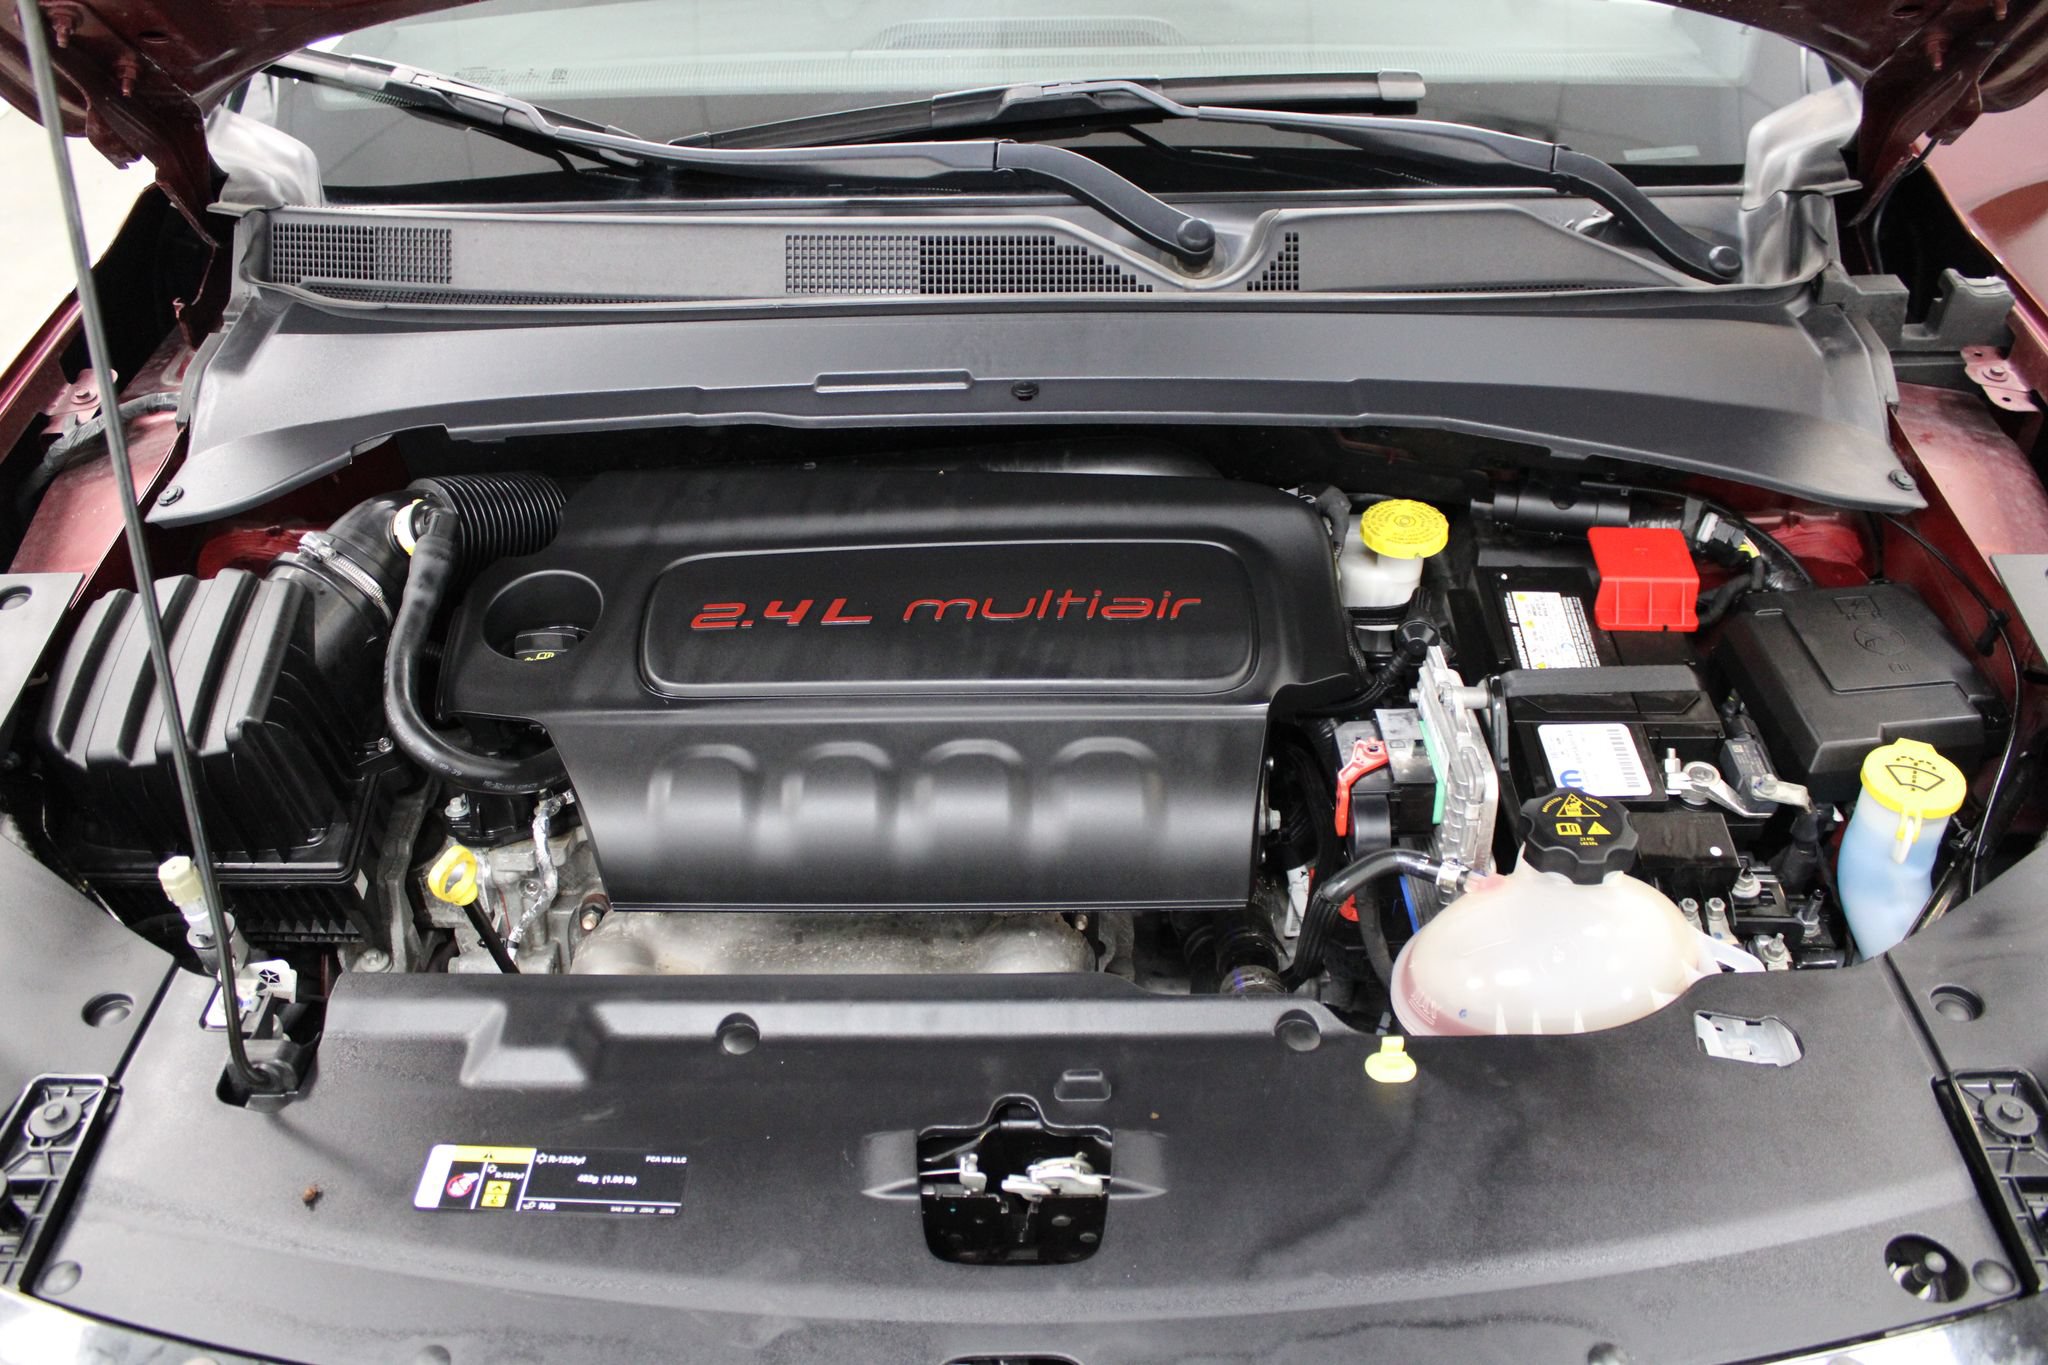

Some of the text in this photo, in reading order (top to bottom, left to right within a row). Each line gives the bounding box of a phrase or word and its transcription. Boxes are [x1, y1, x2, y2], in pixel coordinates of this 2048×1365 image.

[902, 589, 1202, 623] multiair
[548, 1154, 587, 1166] R-1234yf
[645, 1154, 688, 1164] FCA US LLC
